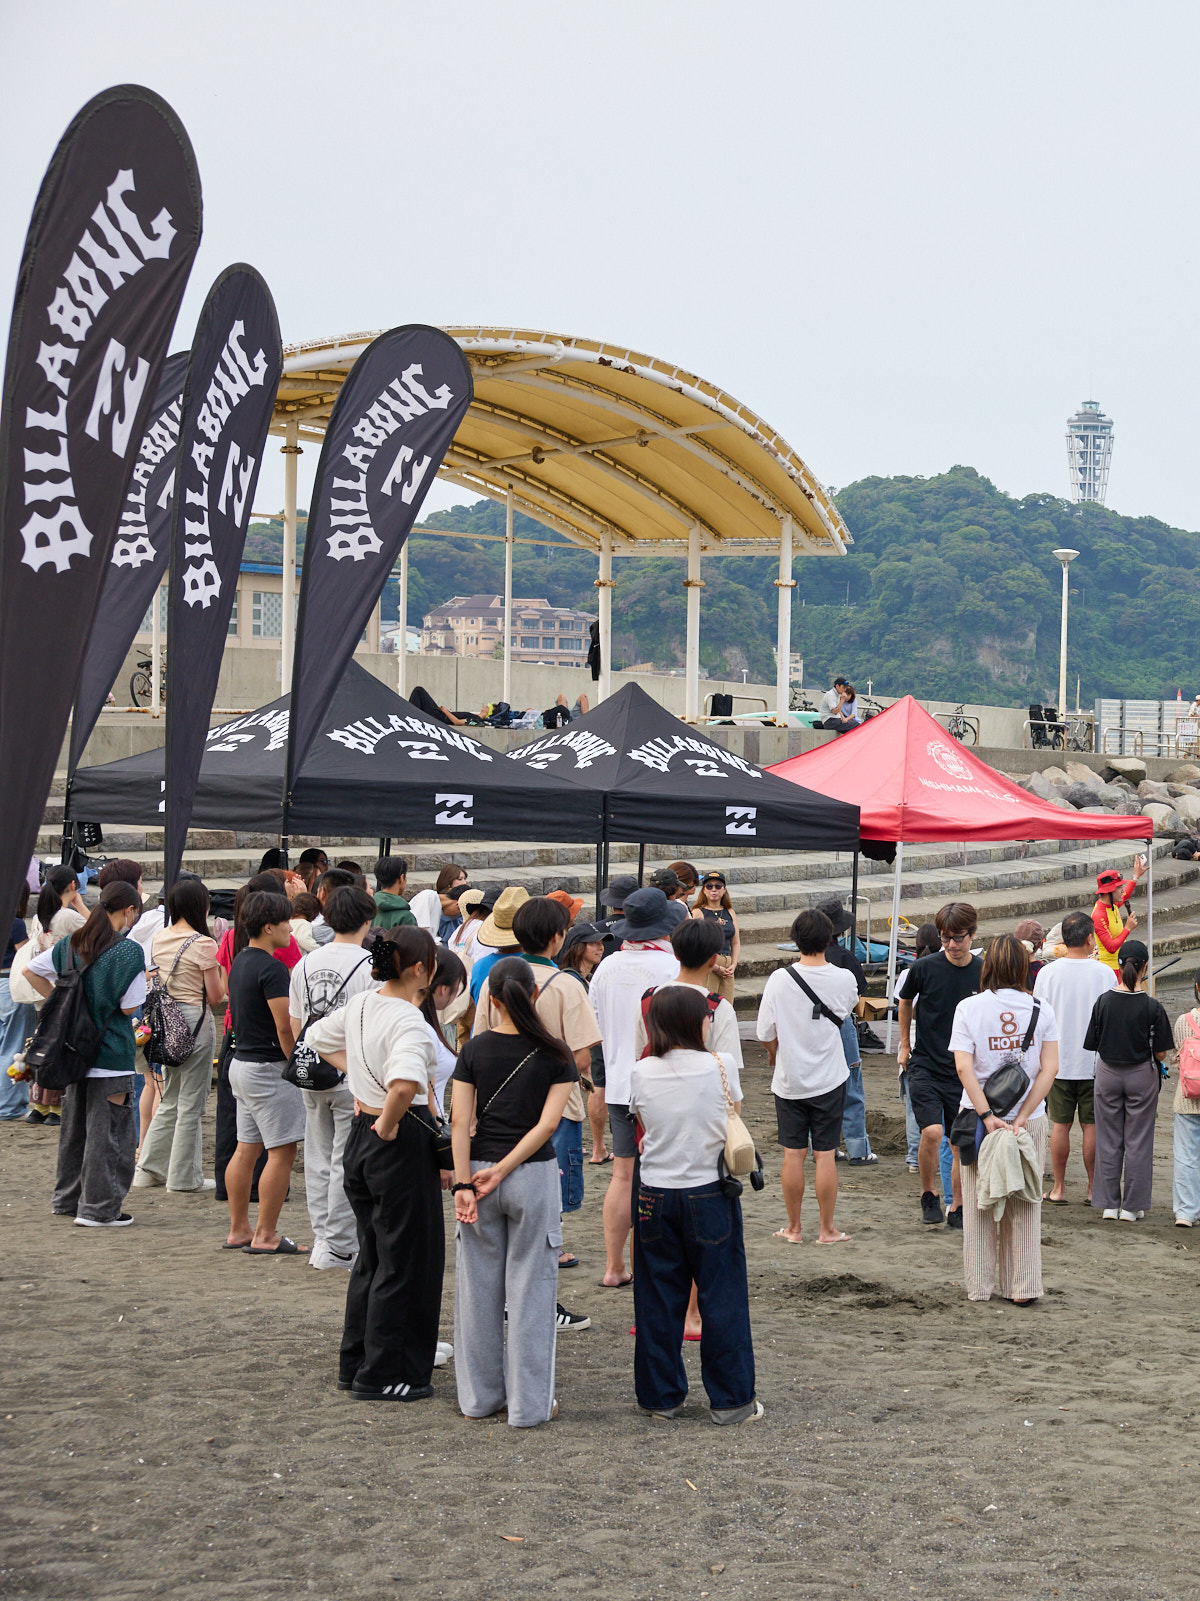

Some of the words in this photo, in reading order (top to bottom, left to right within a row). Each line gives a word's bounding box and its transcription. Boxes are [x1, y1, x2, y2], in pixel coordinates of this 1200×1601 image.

[20, 168, 178, 574] BILLABONG
[110, 393, 184, 569] BILLABON
[182, 320, 268, 610] BILLABONG
[326, 363, 454, 562] BILLABONG
[326, 714, 493, 762] BILLABONG
[627, 735, 762, 779] BILLABONG
[990, 1034, 1033, 1050] HOTE
[1000, 1011, 1018, 1035] 8
